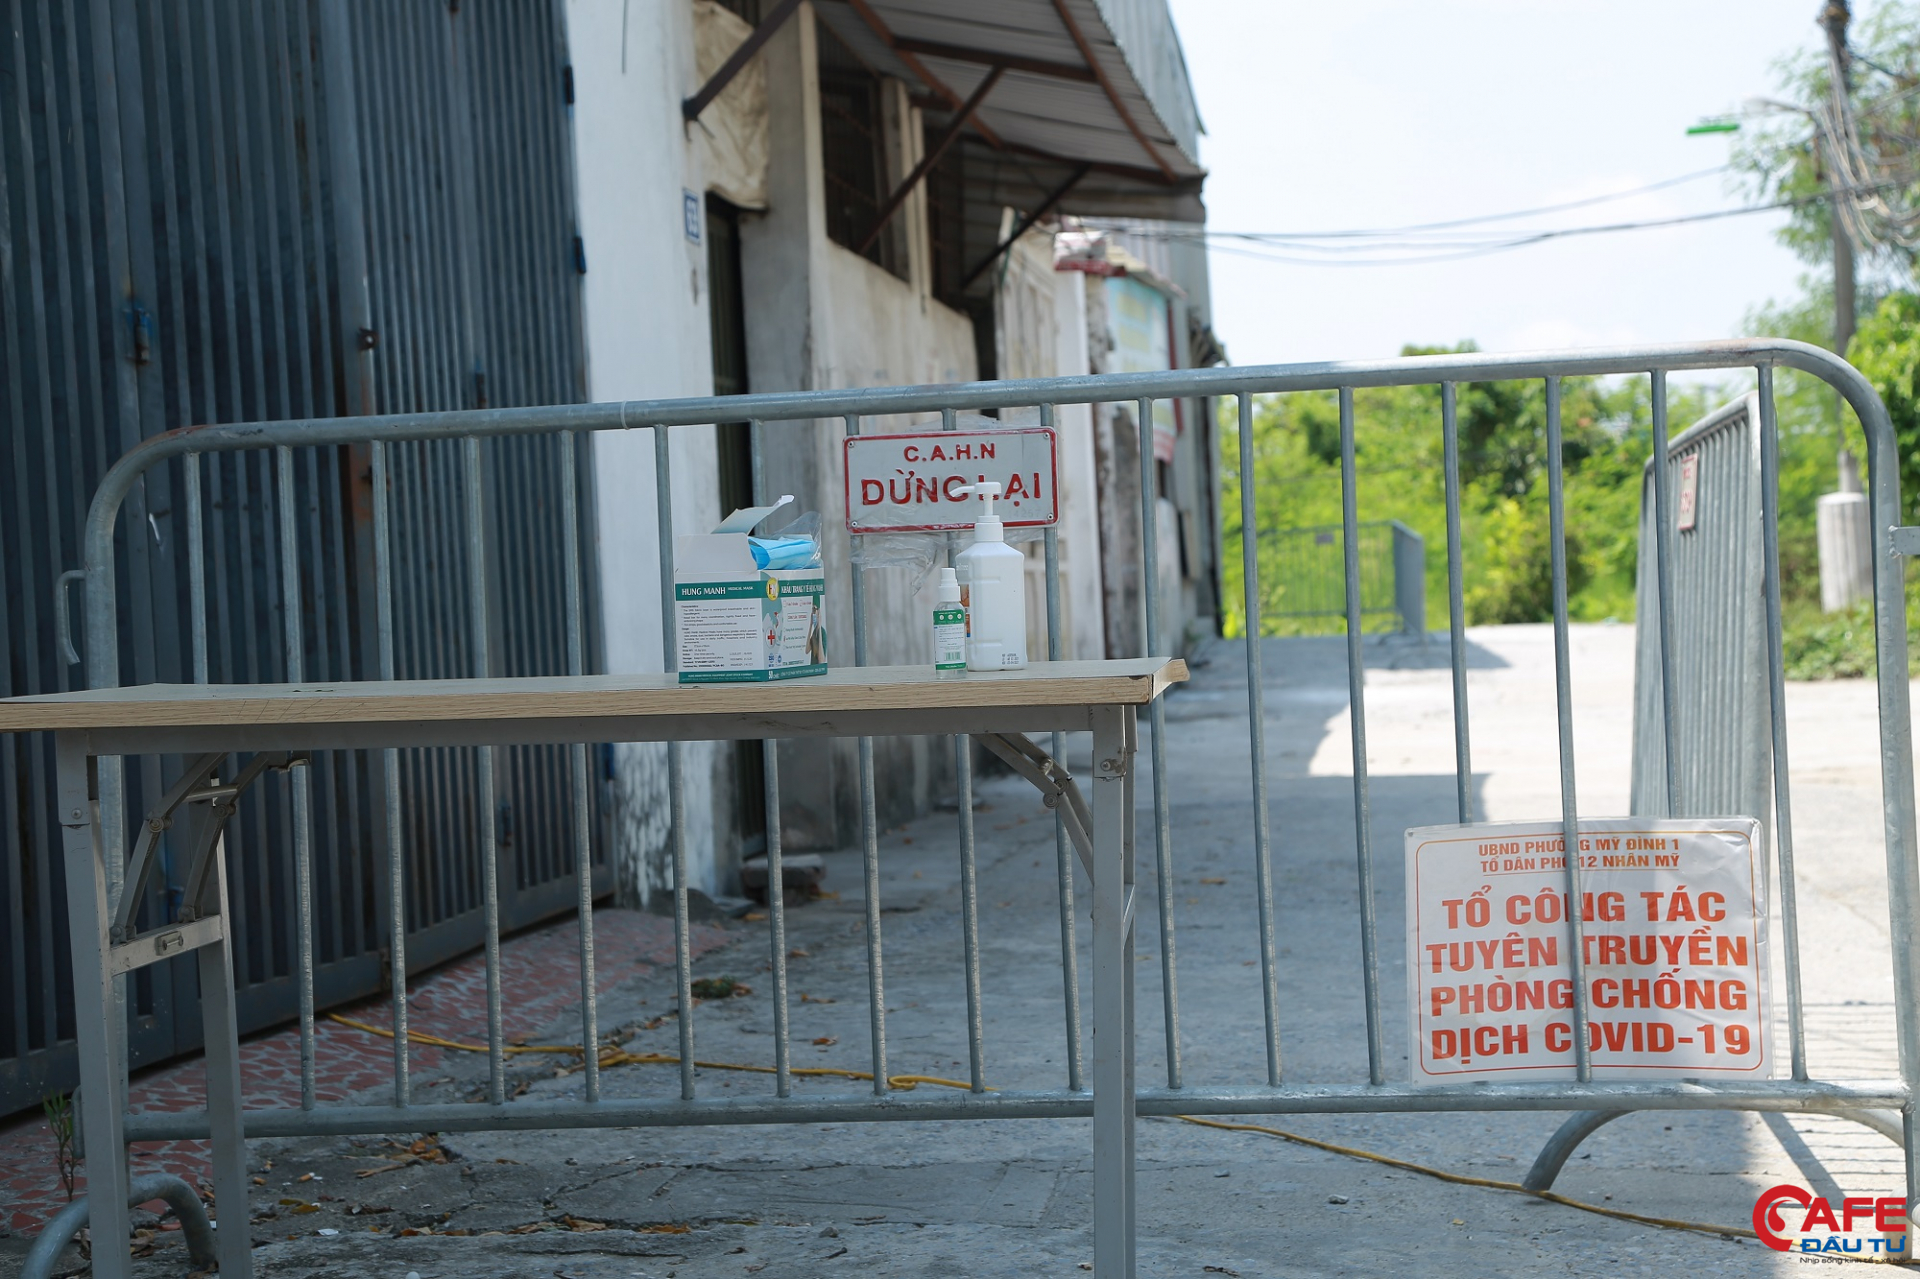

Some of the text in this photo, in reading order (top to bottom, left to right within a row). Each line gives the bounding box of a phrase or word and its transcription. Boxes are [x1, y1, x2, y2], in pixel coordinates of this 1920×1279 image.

[903, 442, 996, 463] C.A.H.N
[681, 587, 702, 596] HUNG
[703, 586, 726, 595] MANH
[1478, 835, 1679, 857] UBND PHƯỜG MỸ ĐÌNH 1
[1503, 857, 1536, 872] DÂN
[1578, 855, 1598, 868] 12
[1602, 853, 1650, 868] NHÂN
[1655, 852, 1680, 868] MỸ
[1441, 884, 1492, 930] TỔ
[1640, 885, 1727, 923] TÁC
[1425, 925, 1748, 974] TUYÊN TRUYỀN
[1430, 967, 1748, 1017] PHÒNG CHỐNG
[1431, 1023, 1529, 1065] DỊCH
